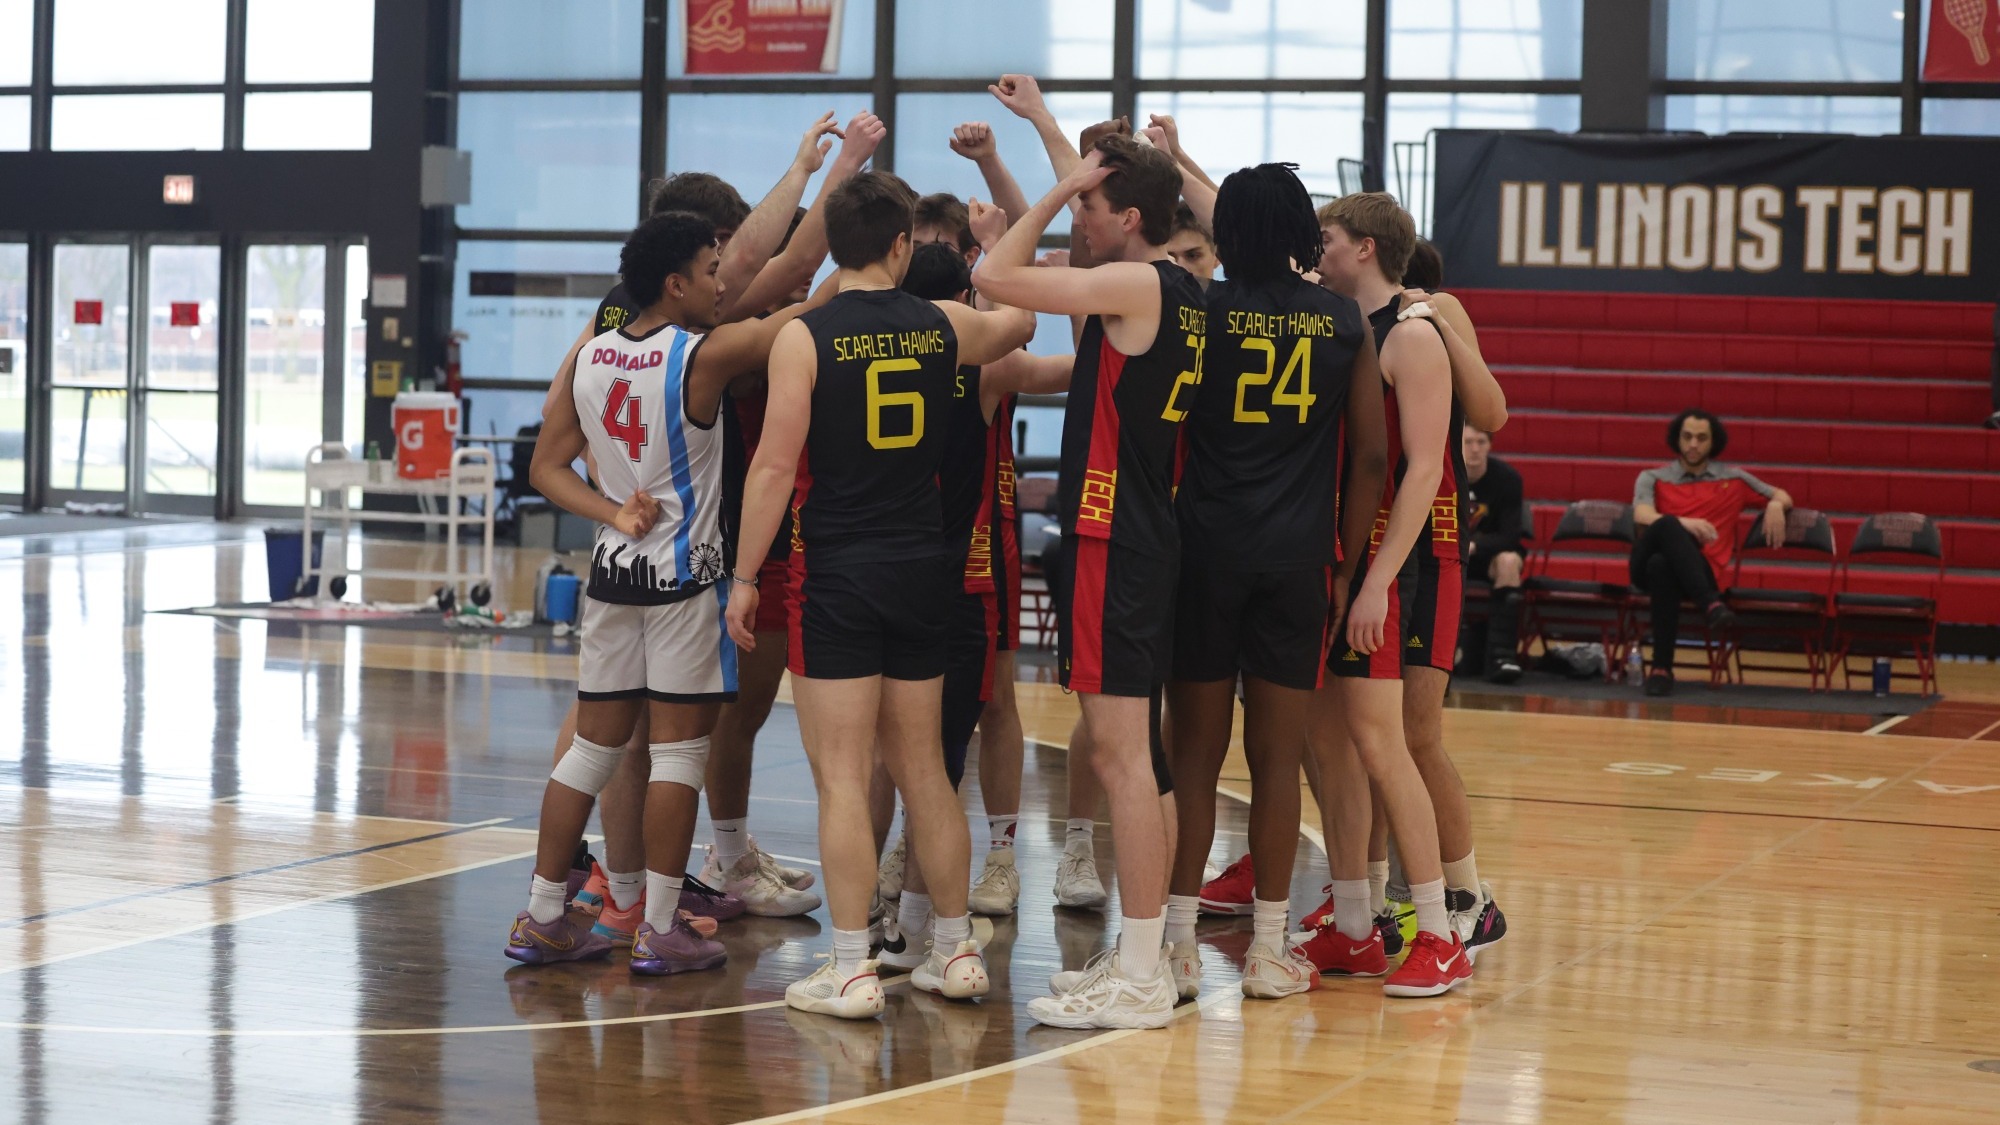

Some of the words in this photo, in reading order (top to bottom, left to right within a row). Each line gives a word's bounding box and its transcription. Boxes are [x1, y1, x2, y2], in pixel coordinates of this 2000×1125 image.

[1499, 181, 1785, 272] ILLINOIS
[1796, 186, 1974, 276] TECH
[834, 333, 895, 362] SCARLET
[898, 329, 945, 356] HAWKS
[1226, 310, 1285, 338] SCARLET
[1288, 312, 1334, 338] HAWKS
[591, 348, 664, 371] DONALD
[1233, 337, 1317, 424] 24
[600, 377, 649, 463] 4
[865, 357, 925, 450] 6
[402, 420, 424, 450] G
[1079, 468, 1118, 524] TECH
[1431, 491, 1458, 543] TECH
[964, 525, 992, 577] ILLINOIS
